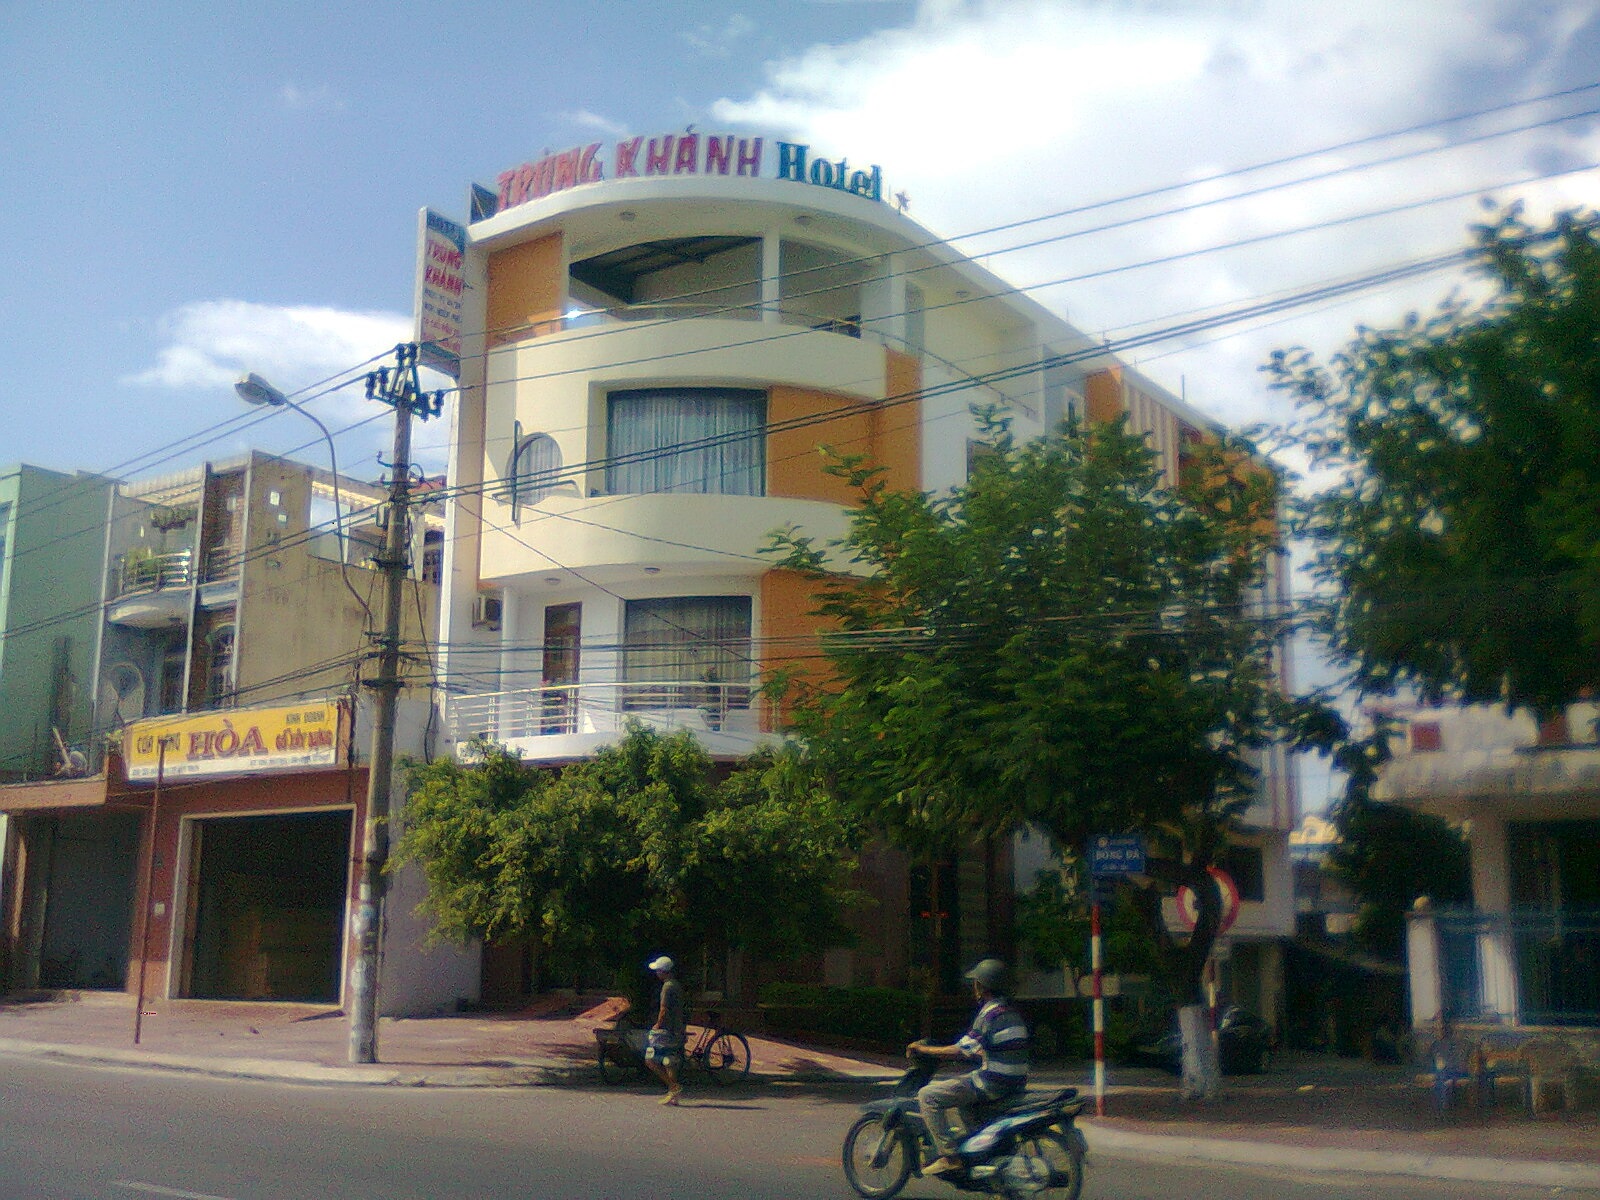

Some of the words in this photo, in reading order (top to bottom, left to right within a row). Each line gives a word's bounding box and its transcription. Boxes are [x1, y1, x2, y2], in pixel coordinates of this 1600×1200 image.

[616, 124, 763, 177] KHÁNH
[776, 141, 882, 202] Hotel
[187, 718, 268, 760] HÒA
